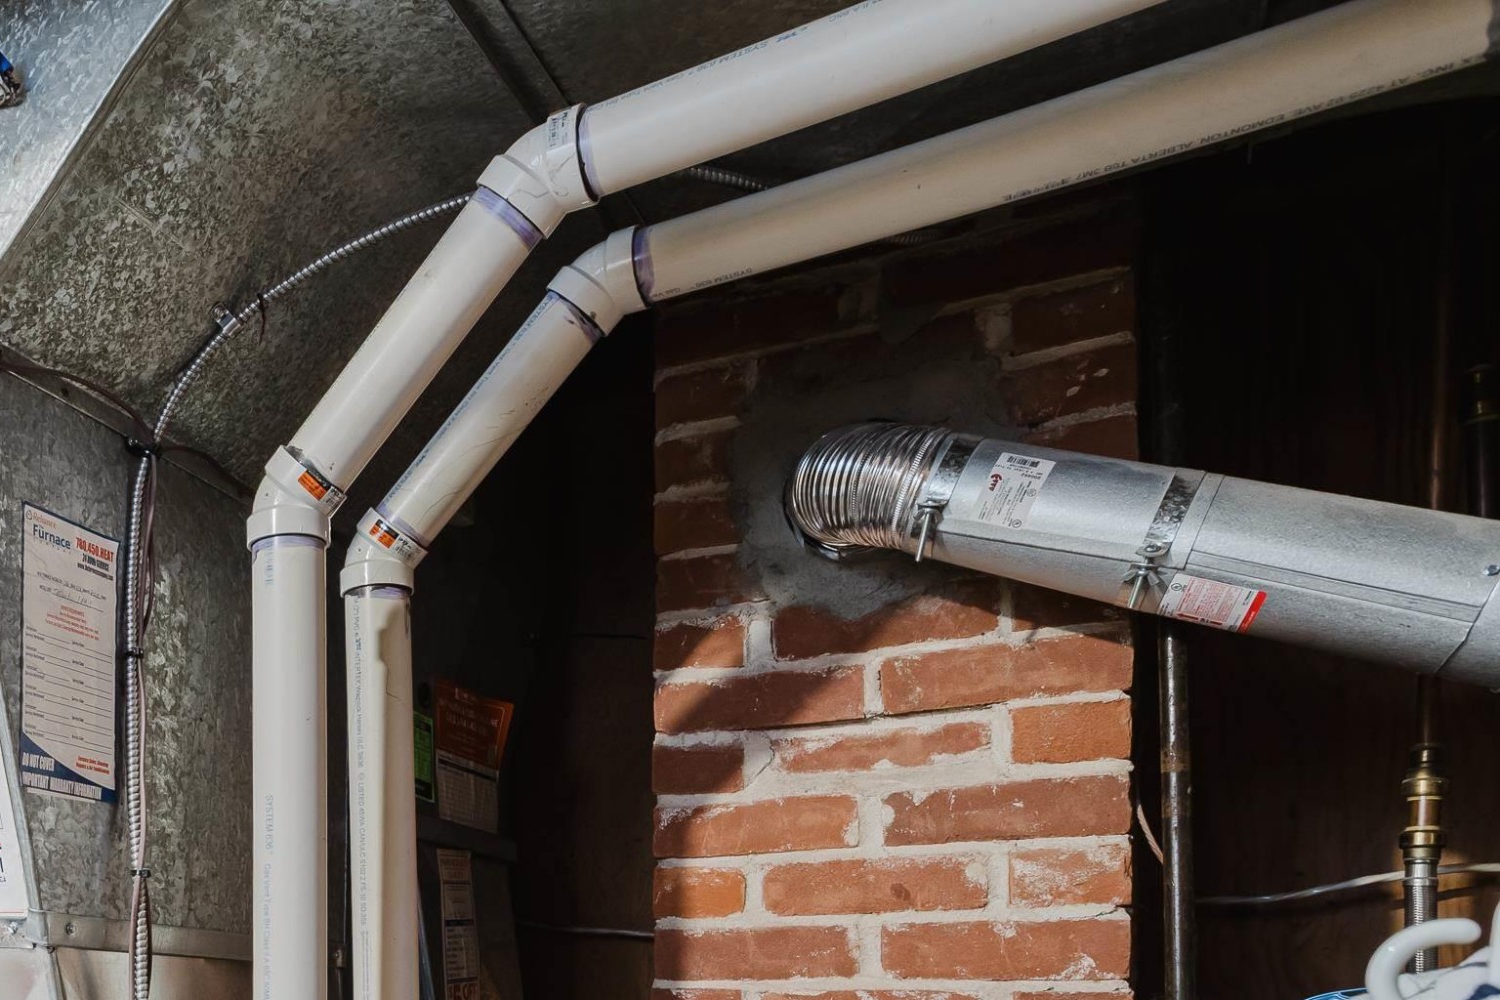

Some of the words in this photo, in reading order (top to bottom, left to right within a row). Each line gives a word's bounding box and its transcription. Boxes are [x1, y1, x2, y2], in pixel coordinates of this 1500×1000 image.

[1130, 140, 1194, 164] ALBERTA
[33, 523, 71, 549] Furnace
[264, 794, 273, 832] SYSTEM
